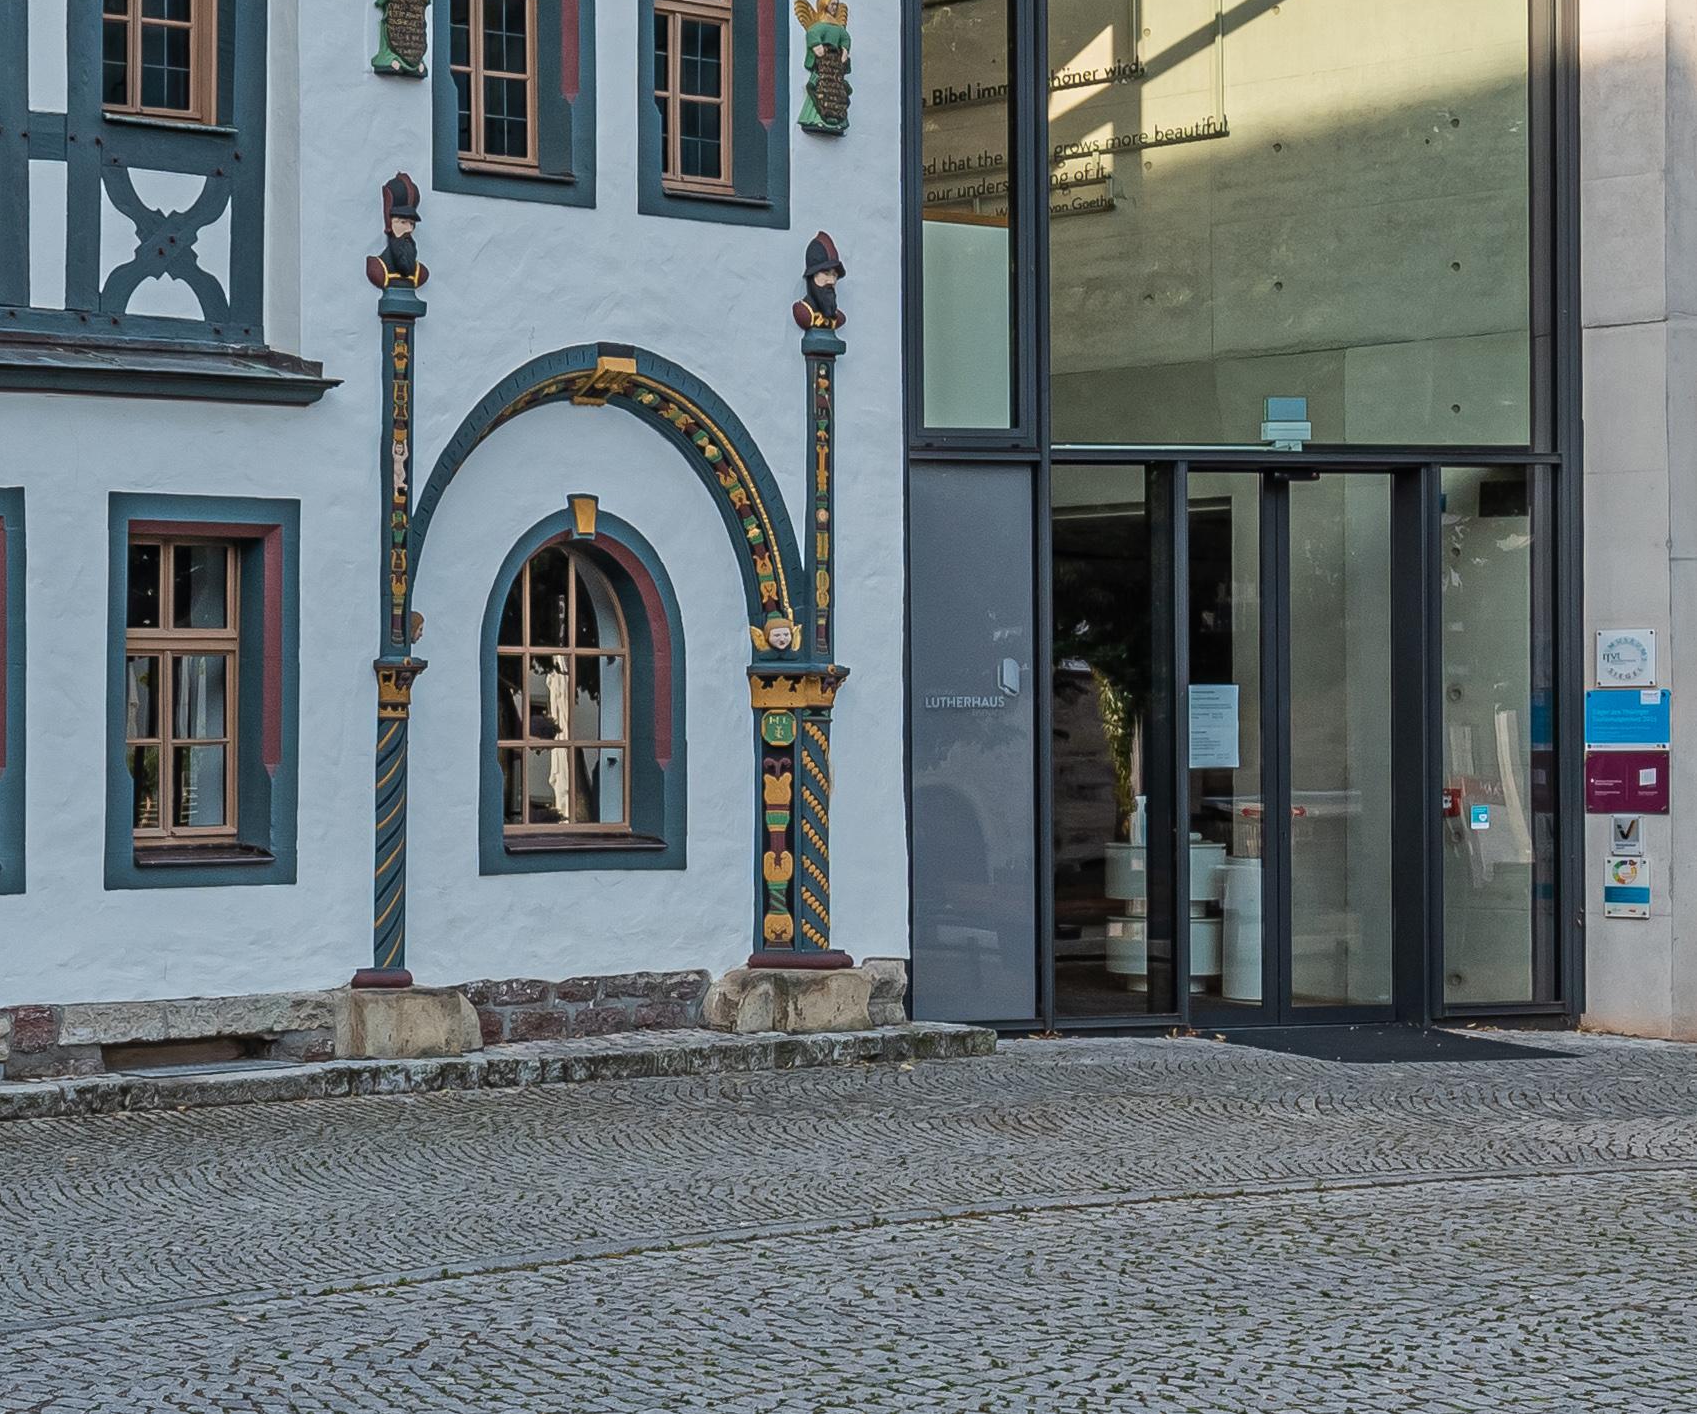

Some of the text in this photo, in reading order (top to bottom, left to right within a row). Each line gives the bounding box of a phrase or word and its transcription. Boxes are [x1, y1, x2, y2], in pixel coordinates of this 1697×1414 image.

[932, 83, 972, 106] Bibel
[942, 154, 972, 173] that
[977, 150, 1004, 168] the
[1054, 138, 1100, 161] grows
[1105, 130, 1149, 150] more
[1154, 114, 1229, 143] beautiful
[927, 188, 954, 203] our
[1074, 162, 1092, 181] of
[1071, 193, 1115, 211] Goethe
[925, 696, 1006, 709] LUTHERHAUS
